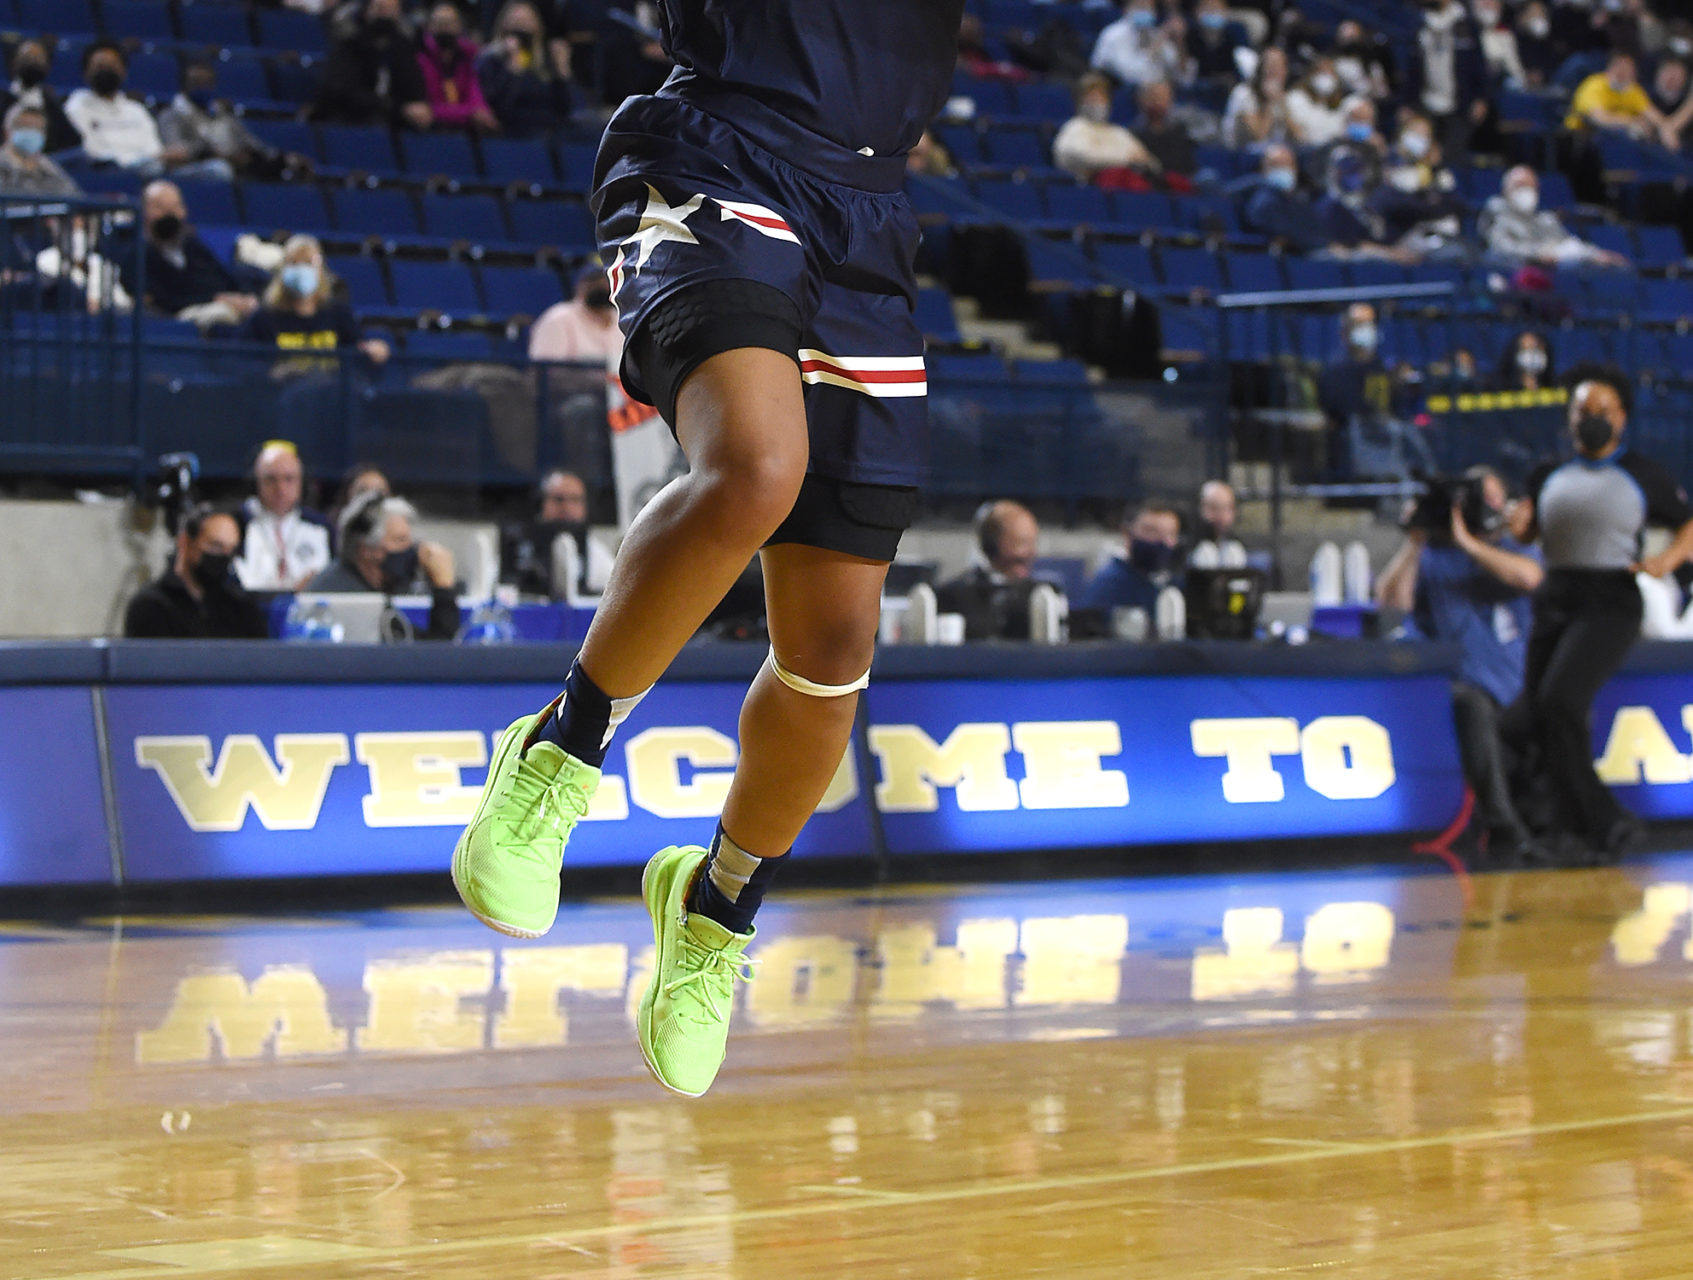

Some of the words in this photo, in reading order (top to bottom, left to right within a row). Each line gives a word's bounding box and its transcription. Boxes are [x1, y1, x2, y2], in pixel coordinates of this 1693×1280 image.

[134, 720, 1130, 832] WECME
[1191, 715, 1396, 803] TO
[1593, 704, 1693, 786] A
